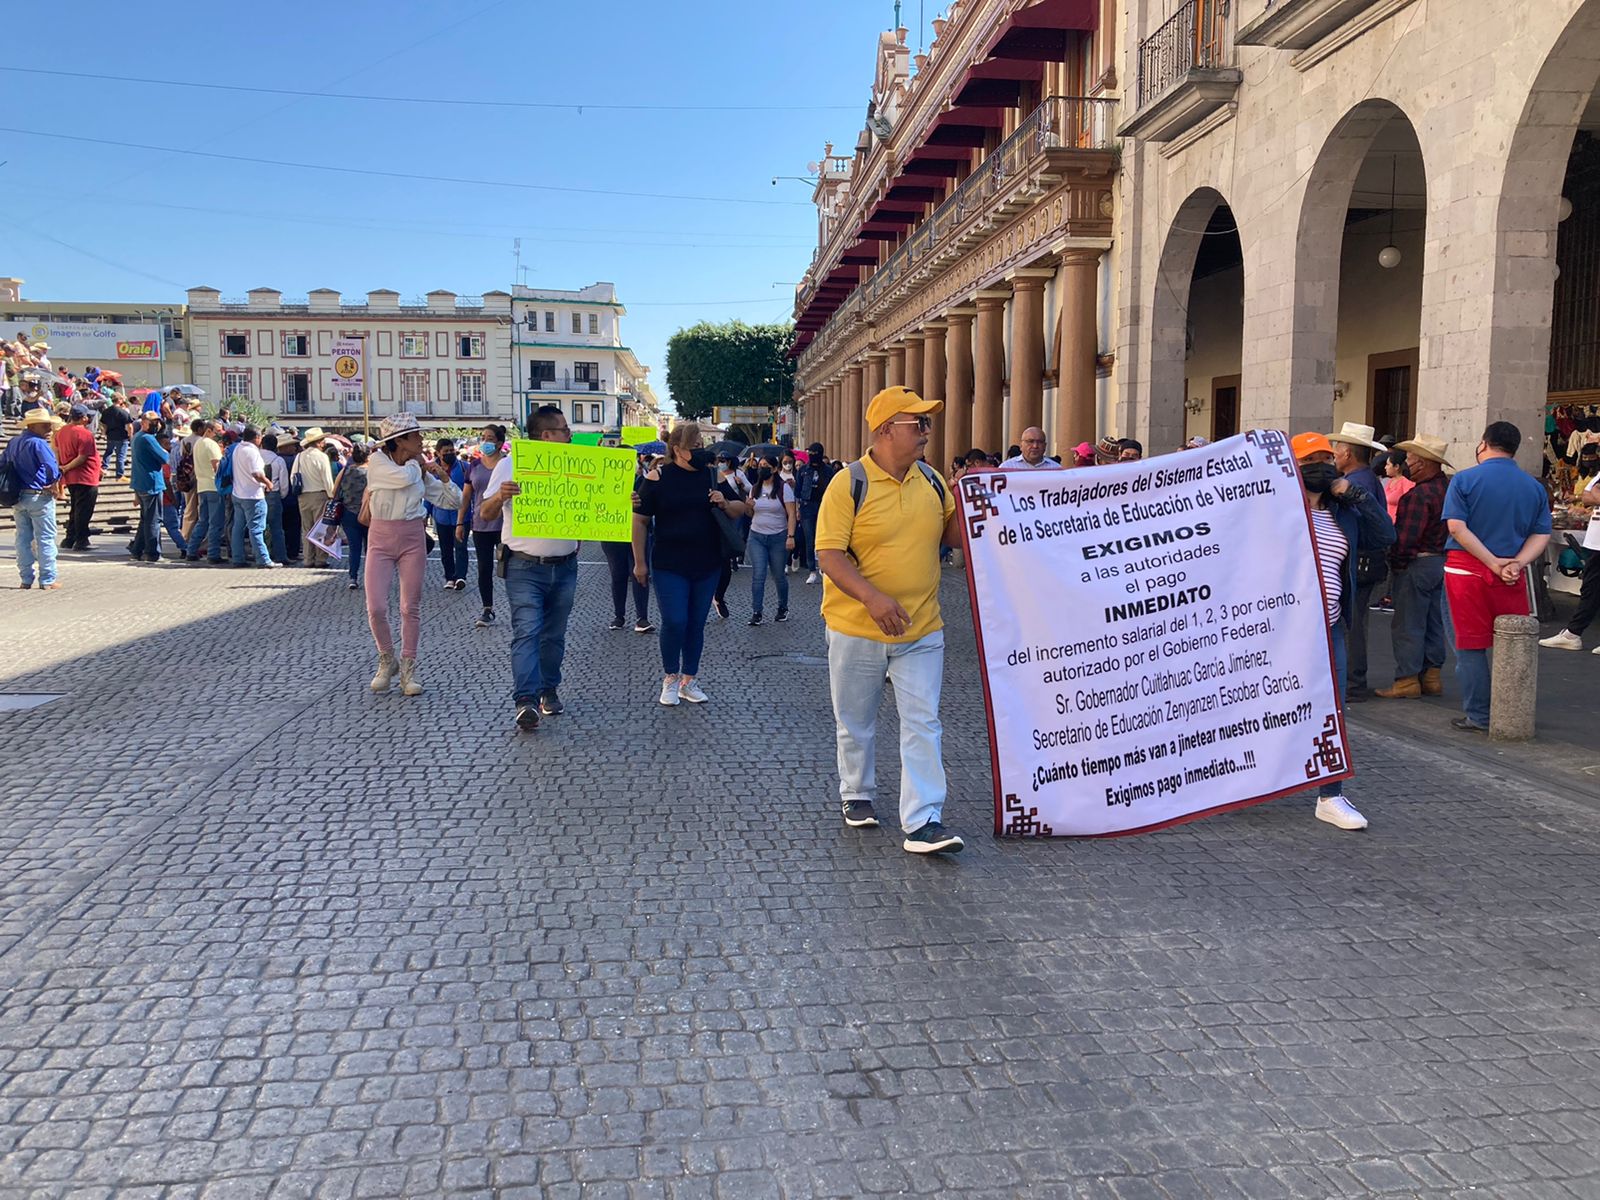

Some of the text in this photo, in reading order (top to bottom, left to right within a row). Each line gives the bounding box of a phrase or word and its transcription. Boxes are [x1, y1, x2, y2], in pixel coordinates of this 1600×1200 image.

[50, 329, 81, 338] Imagen
[93, 329, 117, 338] Golfo
[516, 442, 634, 482] Exigimos pago
[1009, 450, 1253, 513] Los Trabajadores del Sistema Estatal
[559, 496, 591, 510] federal
[594, 502, 606, 514] ya
[584, 483, 605, 502] que
[998, 479, 1276, 546] de la Secretaria de Educación de Veracruz,
[554, 510, 567, 523] al
[595, 509, 628, 525] estatal
[1081, 522, 1211, 561] EXIGIMOS
[1080, 543, 1221, 583] a las autoridades
[1125, 571, 1187, 594] el pago
[1104, 584, 1211, 624] INMEDIATO
[1007, 591, 1300, 667] del incremento salarial del 1, 2, 3 por ciento,
[1043, 617, 1275, 684] autorizado por el Gobierno Federal.
[1055, 650, 1272, 715] Sr. Gobernador Cuitlahuac García Jiménez,
[1032, 674, 1304, 751] Secretario de Educación Zenyanzen Escobar García.
[1032, 701, 1312, 792] ¿Cuánto tiempo más van a jinetear nuestro dinero???
[1105, 750, 1257, 808] Exigimos pago inmediato...!!!
